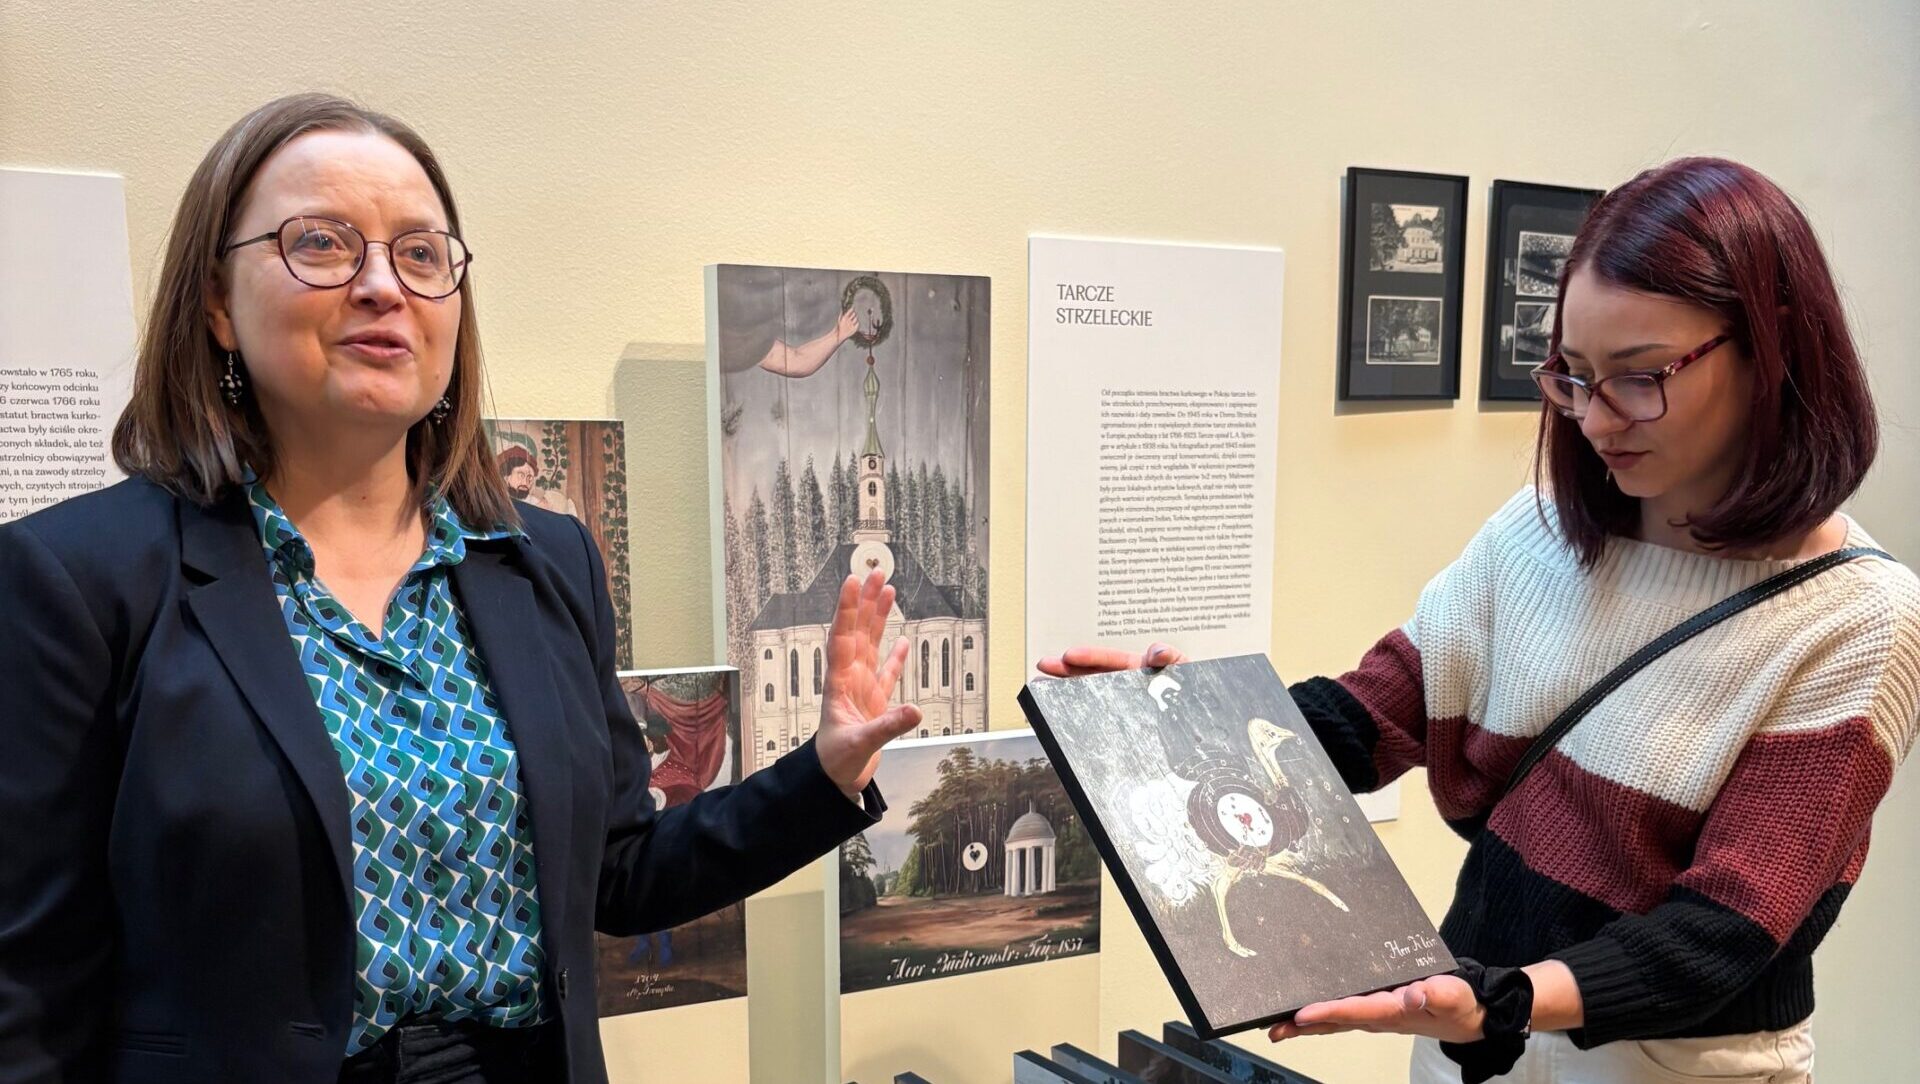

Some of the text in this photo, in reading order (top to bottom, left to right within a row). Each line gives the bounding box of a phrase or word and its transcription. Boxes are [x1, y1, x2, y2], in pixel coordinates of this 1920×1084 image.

[1056, 284, 1114, 302] TARCZE
[1056, 308, 1152, 326] STRZELECKIE
[0, 367, 37, 376] owstało
[50, 368, 72, 377] 1765
[76, 368, 98, 378] roku,
[11, 381, 60, 393] końcowym
[63, 382, 99, 392] odcinku
[53, 396, 76, 406] 1766
[79, 398, 100, 406] roku
[30, 410, 68, 420] bractwa
[72, 411, 101, 420] kurko-
[28, 425, 47, 436] były
[50, 425, 75, 434] ściśle
[78, 425, 102, 434] okre-
[35, 439, 72, 448] składek,
[47, 453, 105, 464] obowiązywał
[0, 468, 11, 477] ni,
[36, 468, 68, 477] zawody
[72, 468, 106, 477] strzelcy
[26, 481, 65, 492] czystych
[68, 482, 105, 491] strojach
[9, 496, 28, 506] tym
[1384, 940, 1410, 958] Herr
